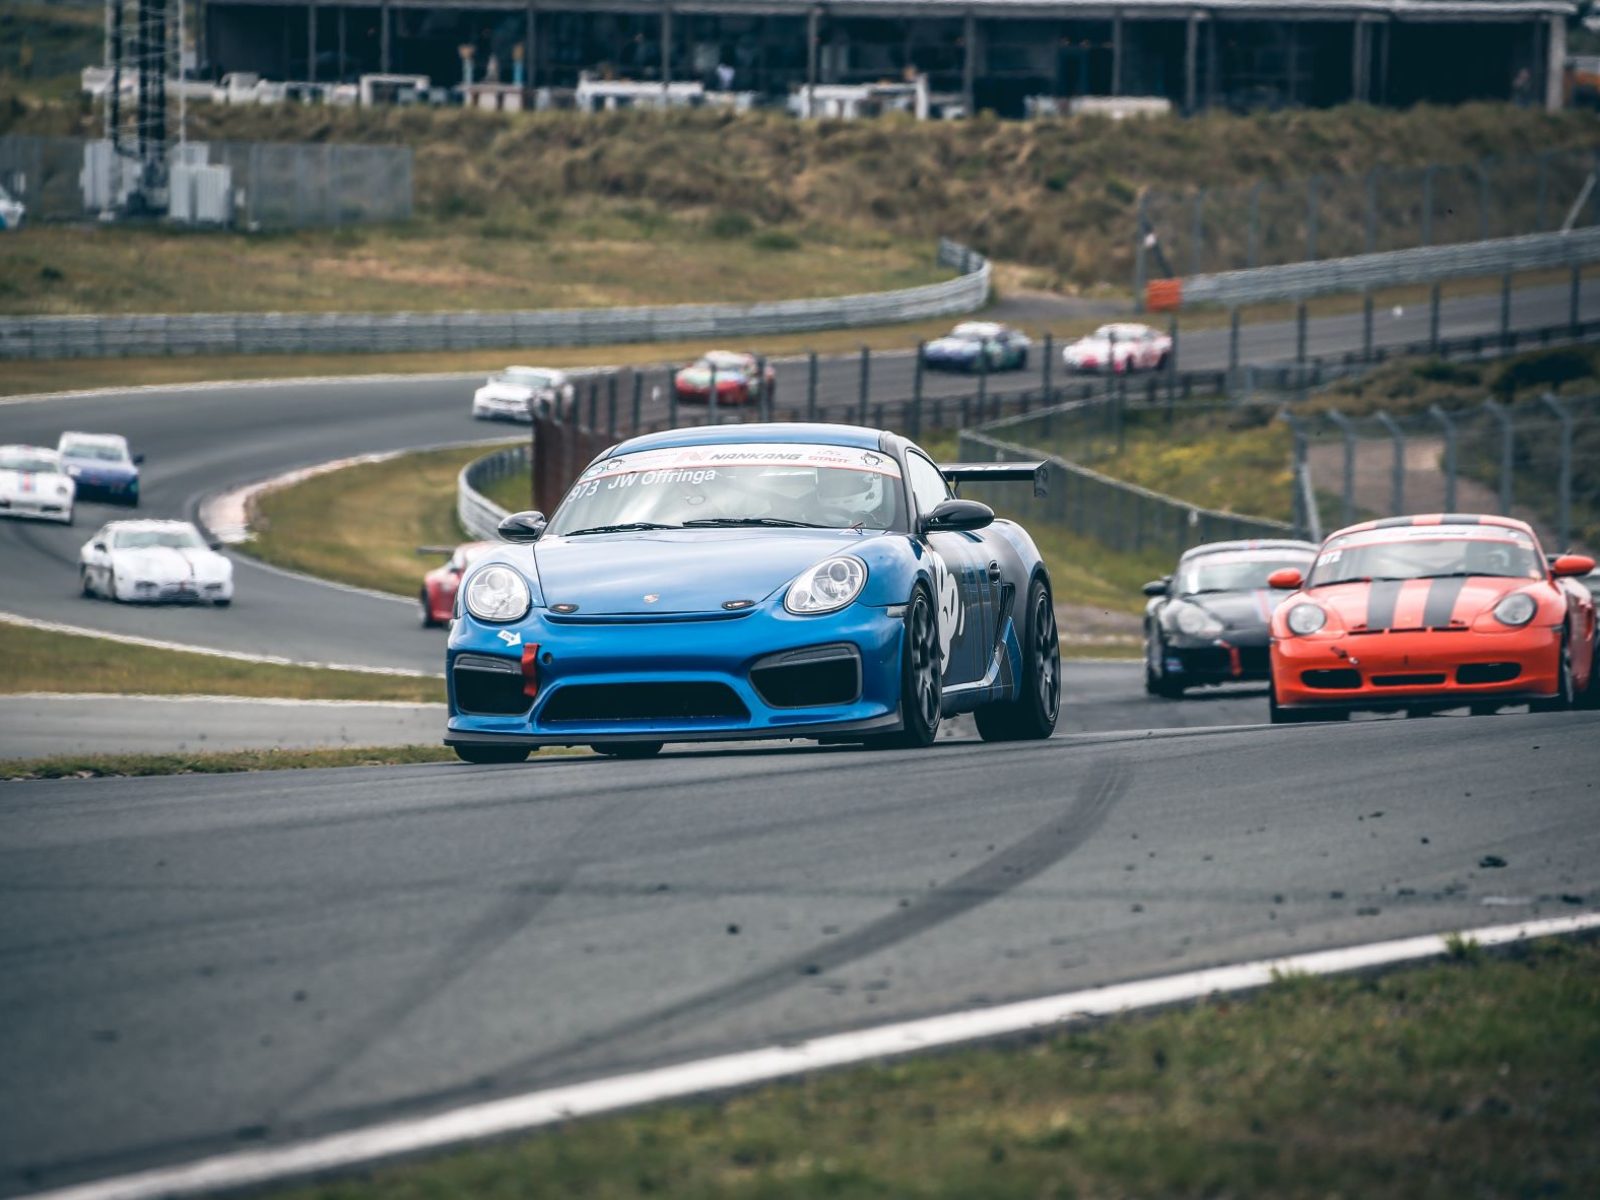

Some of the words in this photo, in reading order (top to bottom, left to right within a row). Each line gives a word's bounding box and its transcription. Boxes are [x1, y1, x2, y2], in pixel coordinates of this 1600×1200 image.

[710, 452, 802, 461] NANKANG
[567, 480, 599, 502] 973
[607, 473, 640, 490] JW
[641, 468, 717, 485] Offringa
